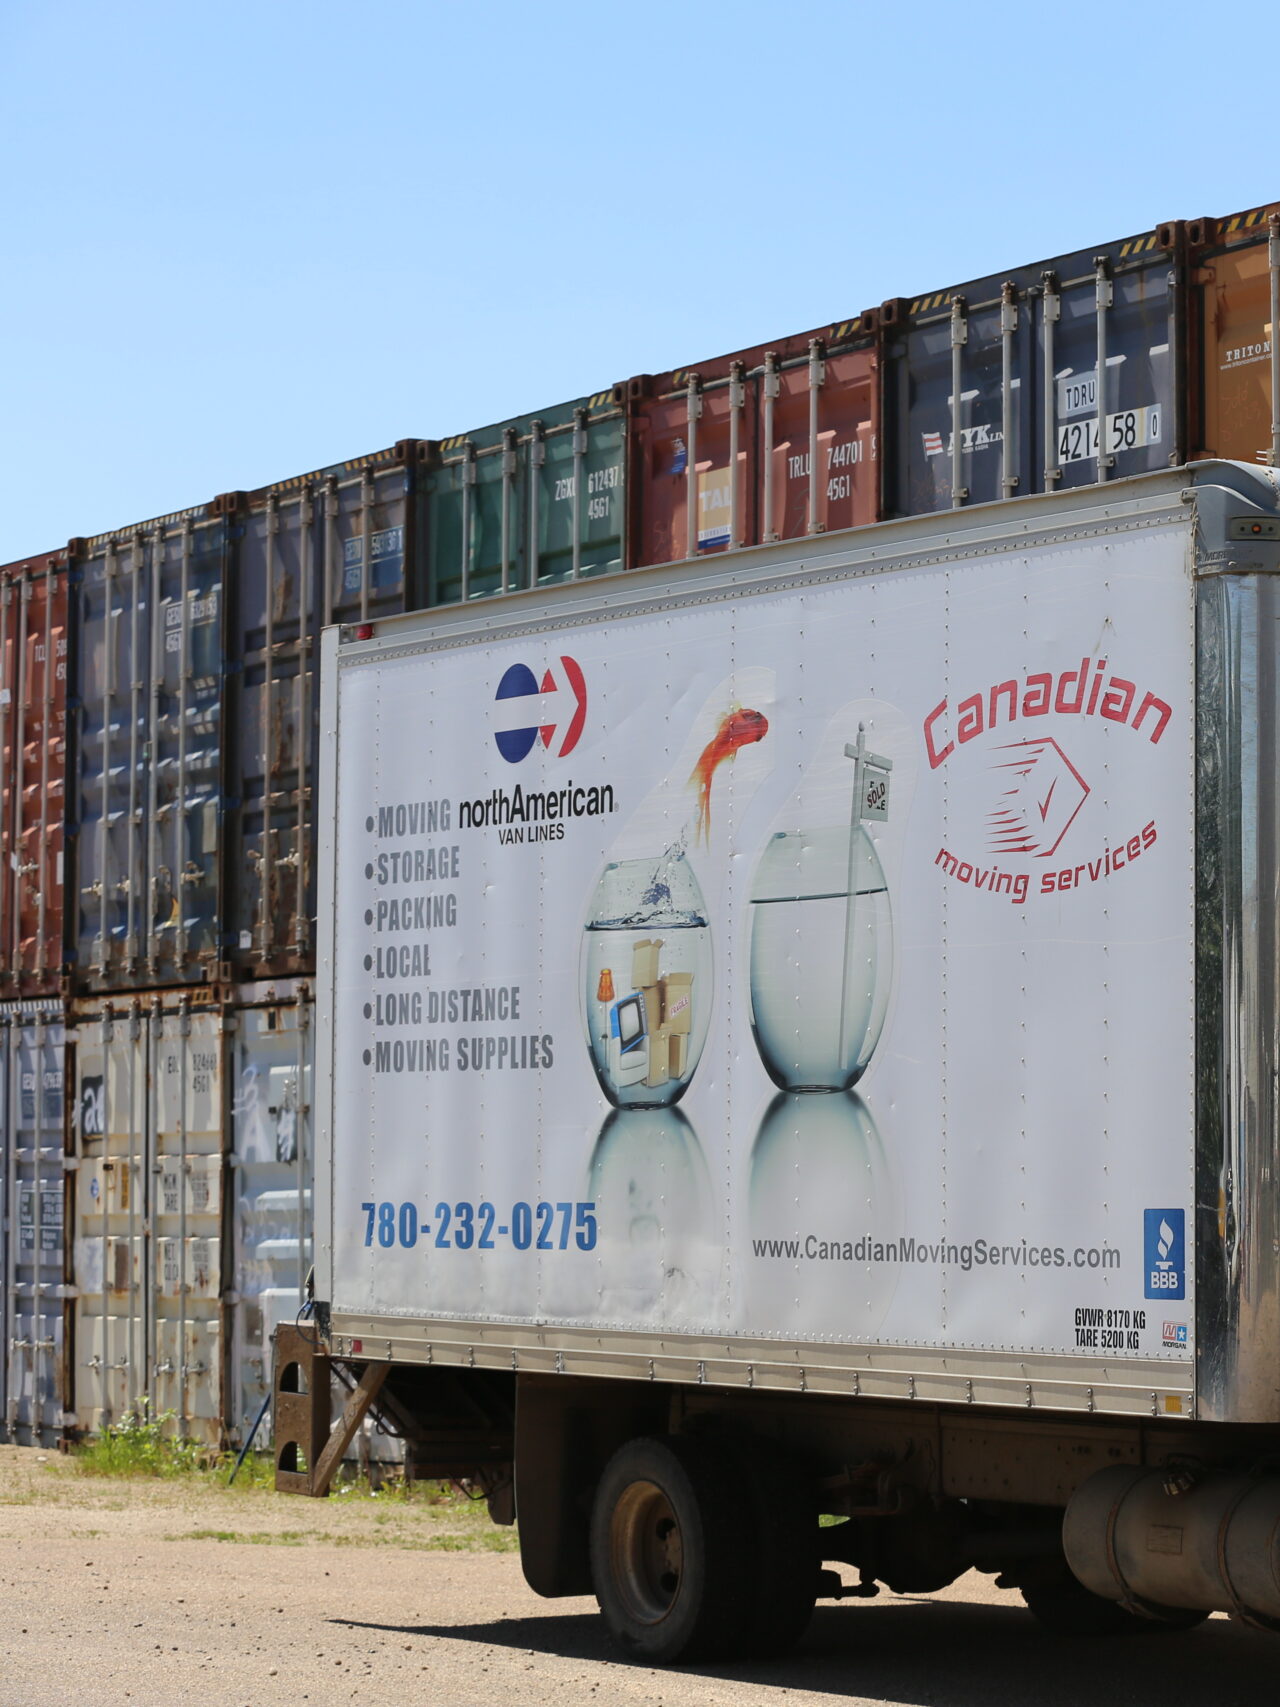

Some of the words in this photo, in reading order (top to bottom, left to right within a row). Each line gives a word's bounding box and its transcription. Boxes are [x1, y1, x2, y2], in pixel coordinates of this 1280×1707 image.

[1226, 342, 1270, 362] TRITON
[1066, 381, 1095, 410] TDRU
[1152, 414, 1157, 437] 0
[827, 440, 863, 470] 744701
[827, 474, 850, 501] 45G1
[924, 657, 1172, 770] Canadian
[459, 780, 614, 829] northAmerican
[867, 782, 886, 808] SOLD
[378, 799, 451, 838] MOVING
[498, 827, 524, 845] VAN
[528, 823, 564, 843] LINES
[377, 845, 459, 886] STORAGE
[934, 847, 1029, 904] moving
[1041, 820, 1157, 893] services
[376, 893, 457, 932] PACKING
[376, 944, 431, 979] LOCAL
[375, 992, 422, 1026] LONG
[428, 986, 520, 1024] DISTANCE
[375, 1039, 450, 1073] MOVING
[457, 1034, 553, 1071] SUPPLIES
[361, 1201, 597, 1251] 780-232-0275
[752, 1235, 1121, 1271] www.CanadianMovingServices.com
[1151, 1272, 1178, 1288] BBB
[1075, 1308, 1103, 1327] GVWR
[1107, 1309, 1130, 1328] 8170
[1133, 1310, 1146, 1329] KG
[1075, 1328, 1098, 1347] TARE
[1101, 1329, 1124, 1348] 5200
[1127, 1331, 1139, 1349] KG
[1162, 1341, 1187, 1349] MORGAN
